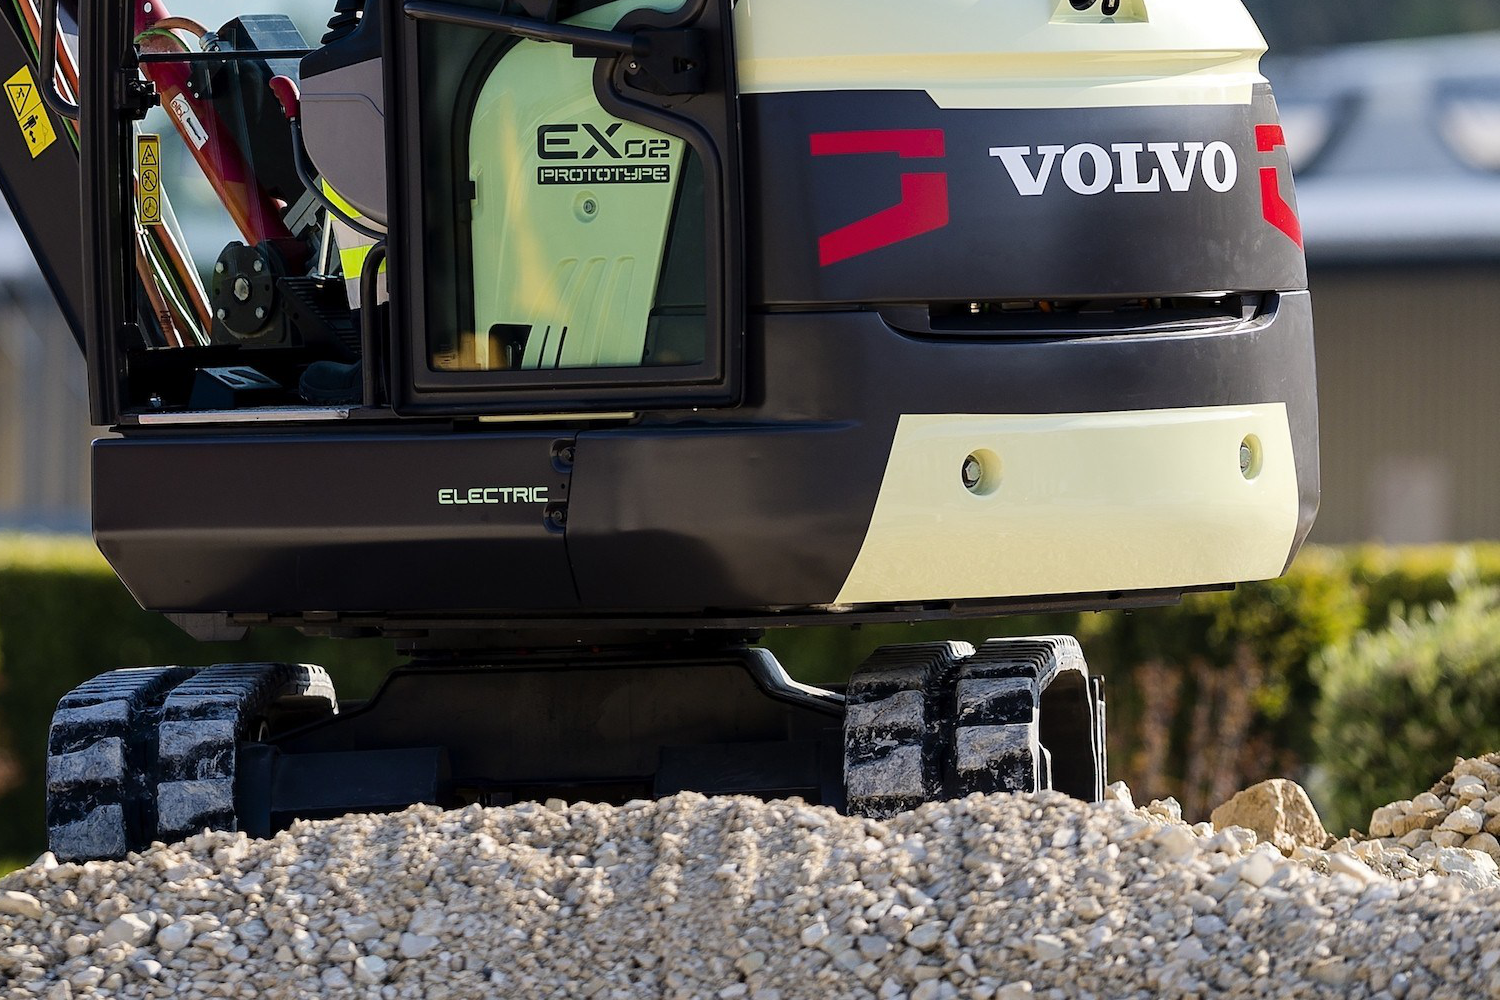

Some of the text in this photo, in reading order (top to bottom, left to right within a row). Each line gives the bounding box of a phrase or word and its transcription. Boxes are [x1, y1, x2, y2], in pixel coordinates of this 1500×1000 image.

[539, 167, 668, 183] PROTOTYPE
[988, 140, 1238, 196] VOLVO
[438, 486, 549, 505] ELECTRIC
